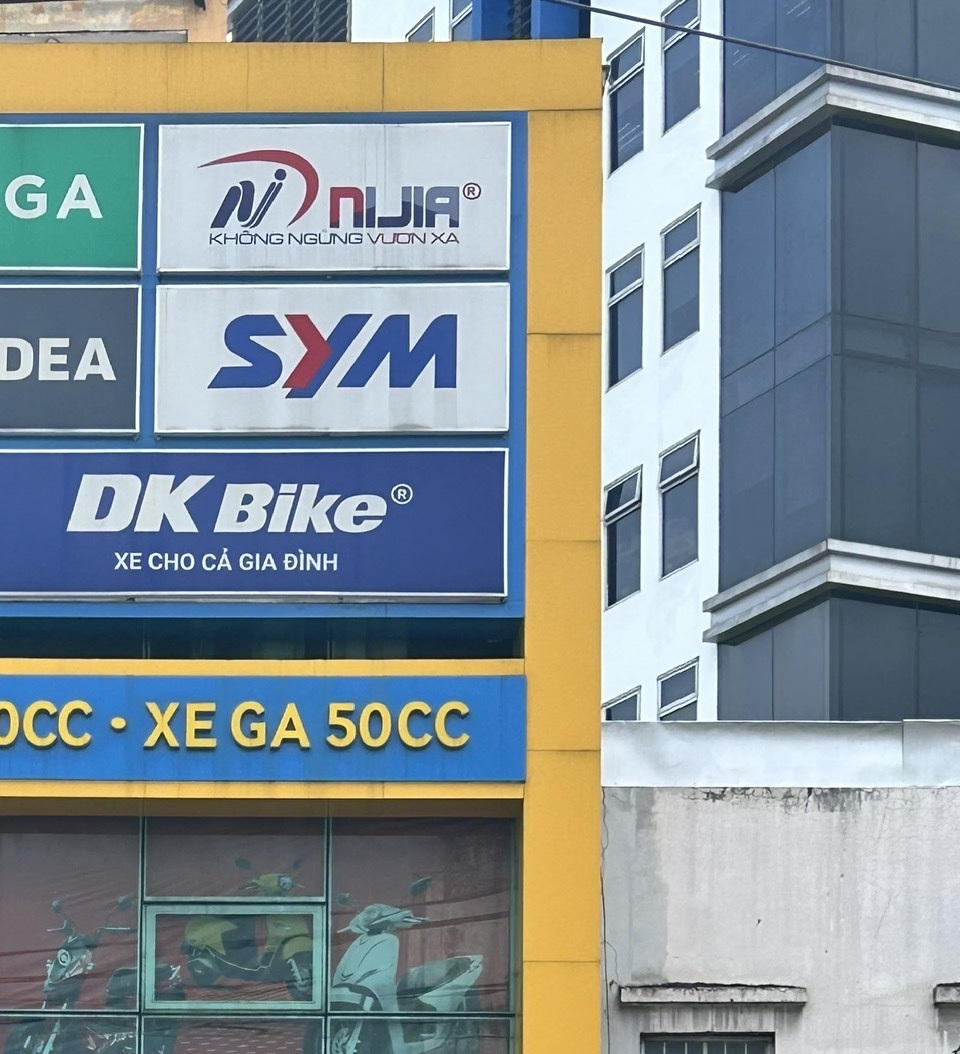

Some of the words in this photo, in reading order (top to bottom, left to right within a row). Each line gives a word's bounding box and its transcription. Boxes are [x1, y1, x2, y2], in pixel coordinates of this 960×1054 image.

[209, 230, 284, 245] KHÔNG
[431, 232, 459, 244] XA
[207, 313, 458, 399] SYM
[66, 473, 215, 533] DK
[213, 483, 388, 534] Bike
[114, 552, 142, 570] XE
[148, 552, 195, 571] CHO
[202, 548, 232, 571] CẢ
[239, 552, 277, 571] GIA
[283, 549, 338, 571] ĐÌNH
[144, 702, 217, 748] XE
[229, 702, 311, 749] GA
[325, 701, 470, 749] 50CC
